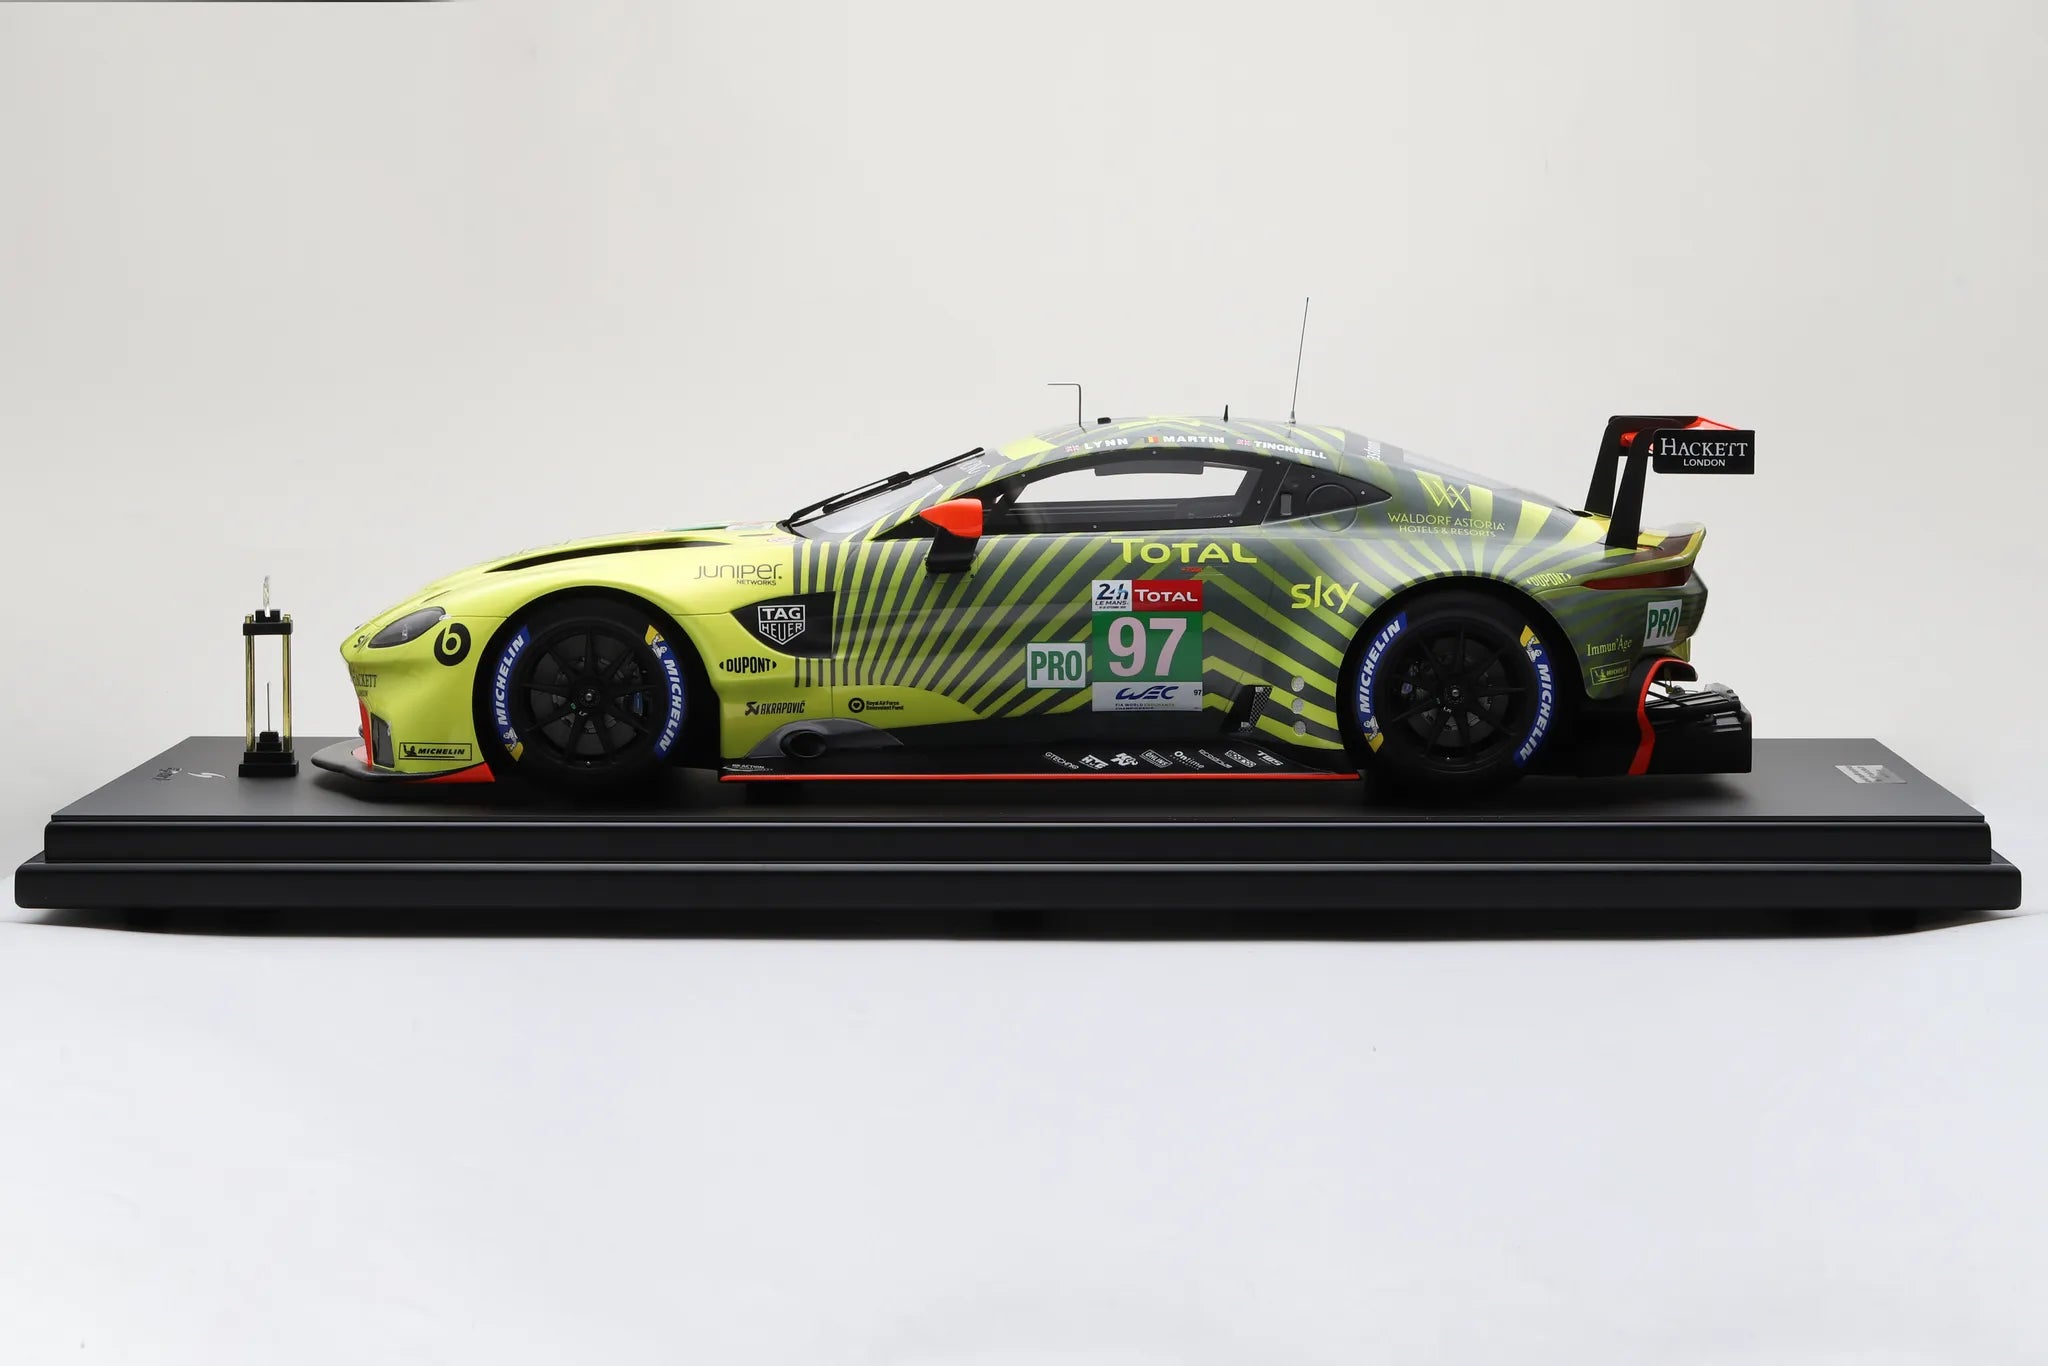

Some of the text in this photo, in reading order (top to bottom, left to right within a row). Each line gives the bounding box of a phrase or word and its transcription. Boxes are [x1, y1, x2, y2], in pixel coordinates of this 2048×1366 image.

[1084, 438, 1129, 450] LYNN
[1254, 440, 1327, 460] TINCKNELL
[1660, 437, 1748, 457] HACKETT
[1683, 458, 1726, 467] LONDON
[1387, 512, 1505, 531] WALDORF ASTORIA
[1399, 525, 1496, 537] HOTELS & RESORTS
[1110, 538, 1258, 564] TOTAL
[1531, 572, 1568, 587] DUPONT
[1134, 588, 1198, 602] TOTAL
[1290, 575, 1360, 614] sky
[762, 607, 801, 620] TAG
[1646, 606, 1679, 640] PRO
[761, 622, 803, 642] HEUER
[1108, 616, 1187, 677] 97
[726, 656, 771, 673] DUPONT
[1030, 650, 1082, 682] PRO
[1359, 619, 1401, 714] MICHELIN
[495, 635, 525, 726] MICHELIN
[1115, 685, 1179, 700] WEC
[663, 659, 682, 751] MICHELIN
[1519, 663, 1552, 760] MICHELIN
